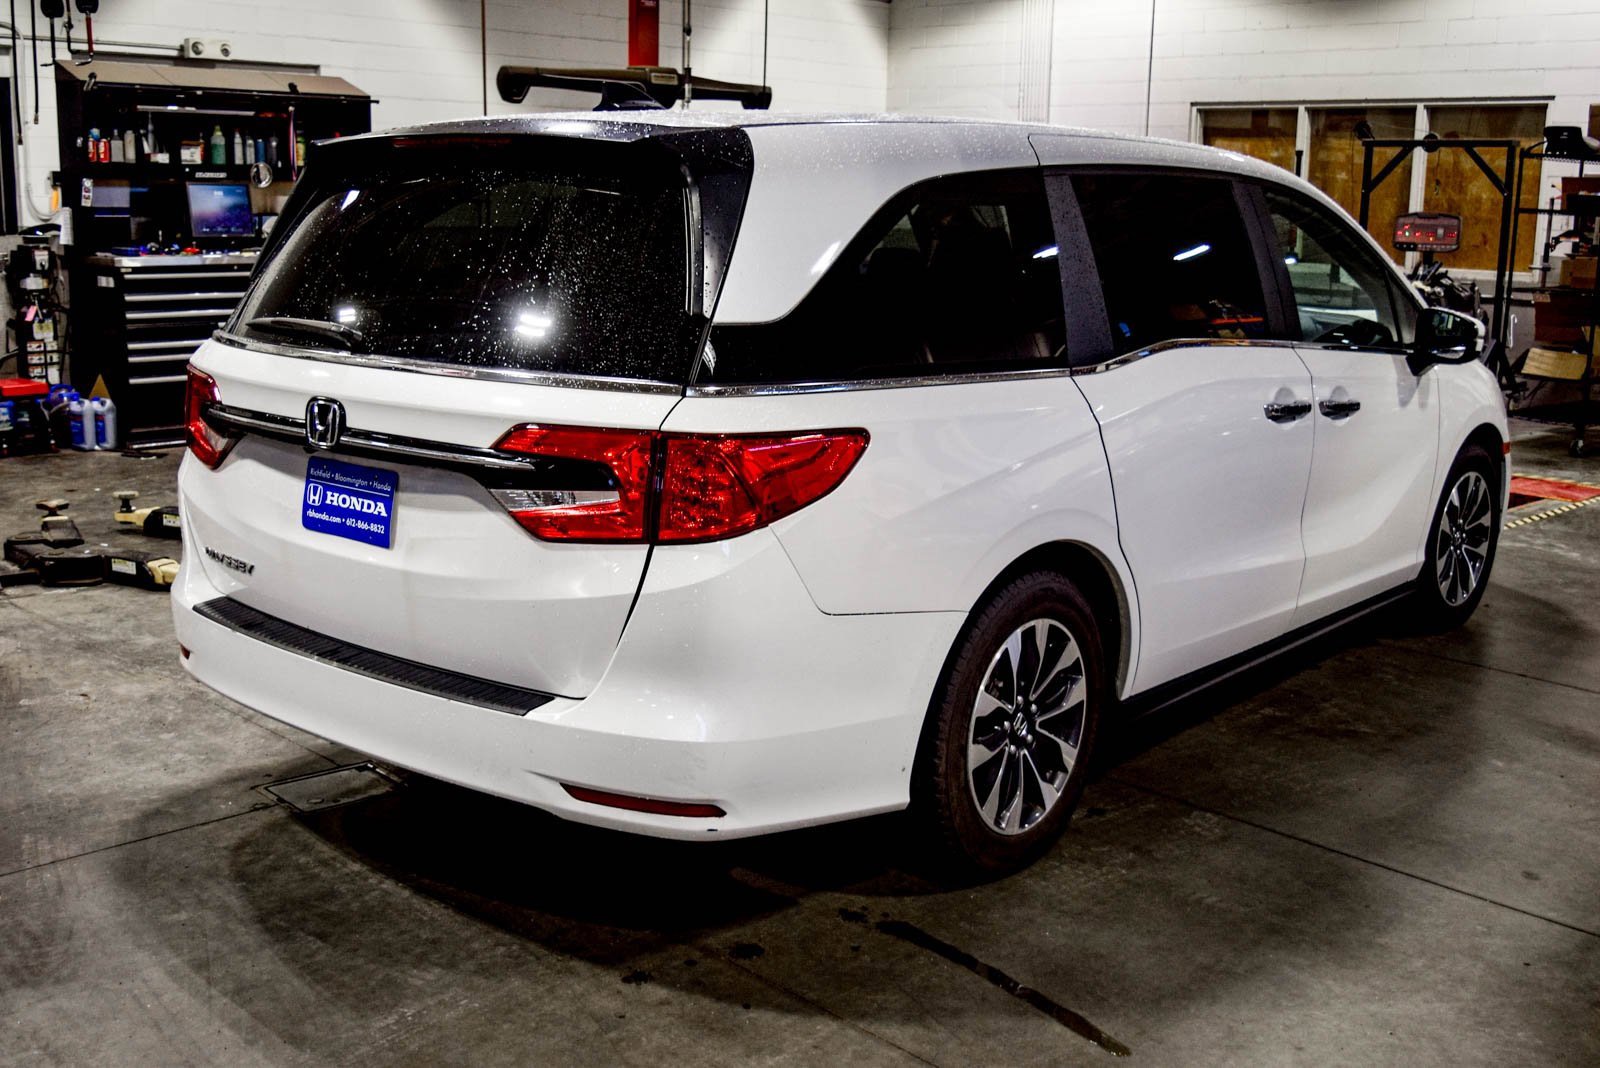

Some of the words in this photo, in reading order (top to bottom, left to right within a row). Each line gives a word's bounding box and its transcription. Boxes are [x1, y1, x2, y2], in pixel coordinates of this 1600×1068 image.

[310, 467, 331, 479] Richfield
[335, 472, 368, 487] Bloomington
[373, 480, 391, 492] Honda
[306, 508, 342, 524] rbhonda.com
[325, 491, 388, 517] HONDA
